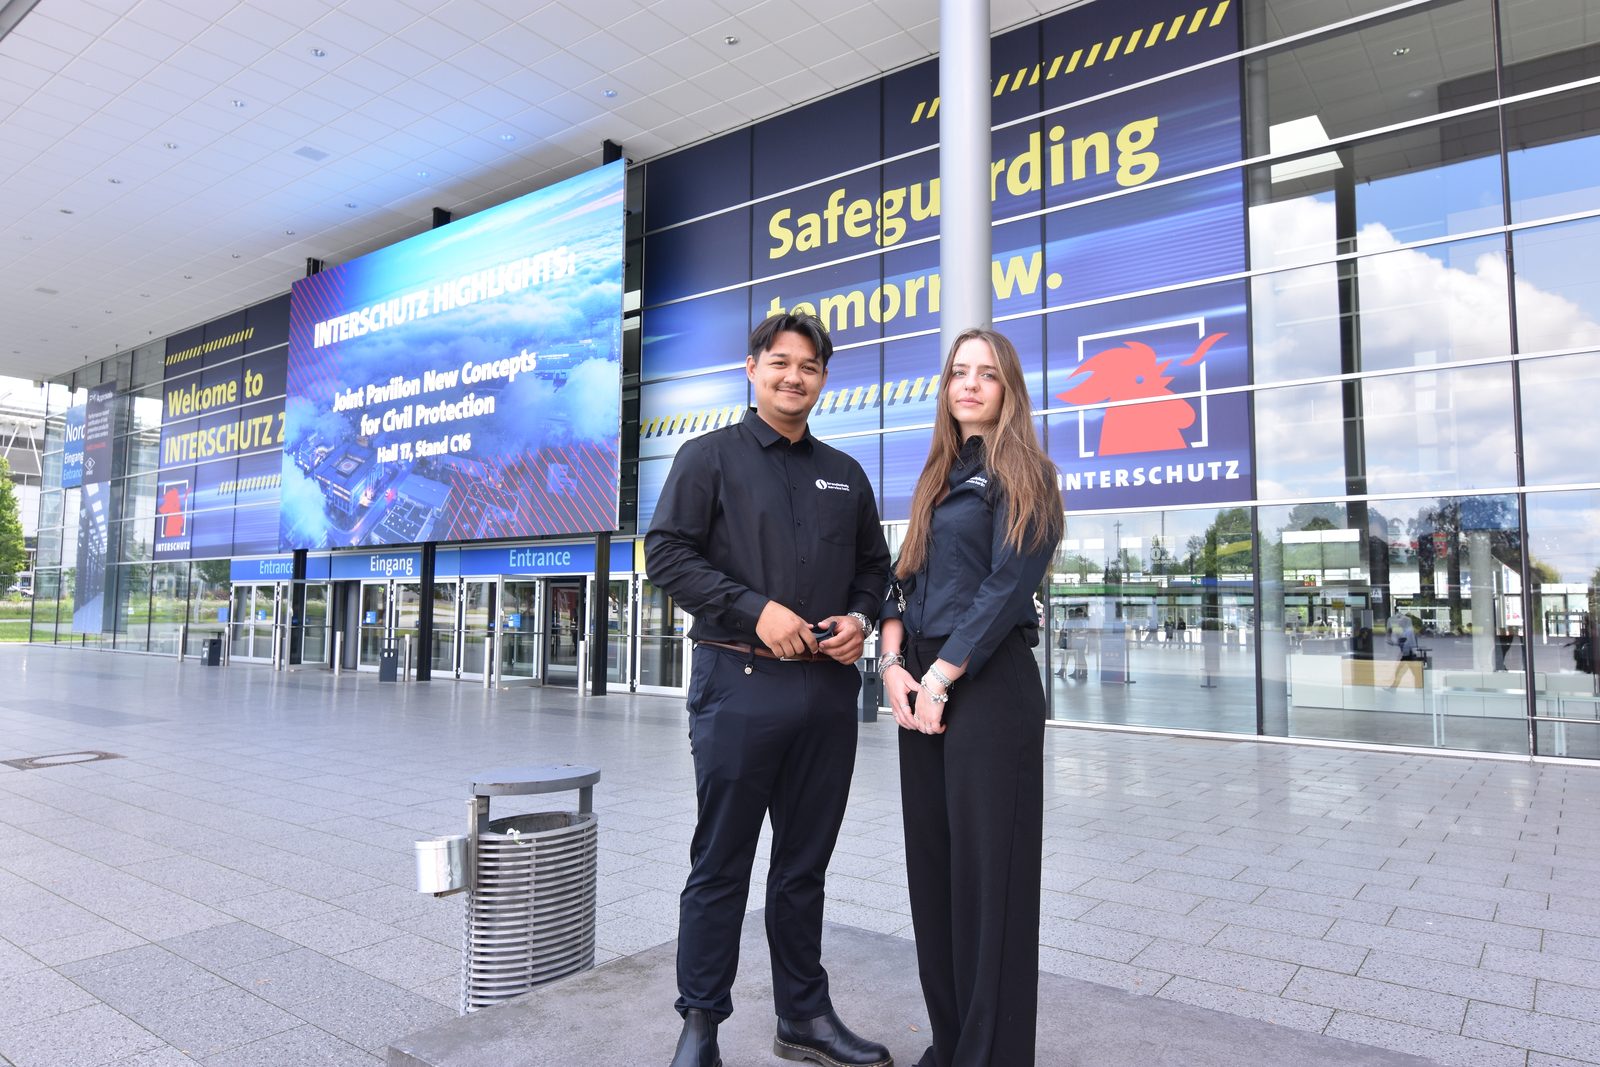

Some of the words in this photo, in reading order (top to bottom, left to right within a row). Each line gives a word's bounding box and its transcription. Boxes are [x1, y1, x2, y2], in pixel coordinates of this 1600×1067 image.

[768, 116, 1160, 260] Safegurding
[314, 289, 430, 349] INTERSCHUTZ
[432, 246, 576, 314] HIGHLIGHTS!
[766, 248, 1063, 334] tmorrw.
[168, 377, 237, 418] Welcome
[244, 369, 264, 397] to
[333, 386, 364, 412] Joint
[366, 376, 420, 405] Pavilion
[423, 369, 459, 393] New
[462, 349, 537, 382] Concepts
[361, 413, 380, 436] for
[383, 405, 413, 432] Civil
[416, 392, 495, 426] Protection
[165, 416, 272, 464] INTERSCHUTZ
[377, 443, 399, 463] Hall
[415, 435, 448, 458] Stand
[450, 433, 471, 452] C16
[63, 468, 82, 480] Entranc
[1057, 460, 1239, 492] INTERSCHUTZ
[155, 541, 190, 552] INTERSCHUTZ
[370, 554, 413, 577] Eingang
[509, 549, 570, 568] Entrance
[260, 560, 294, 574] Entrance
